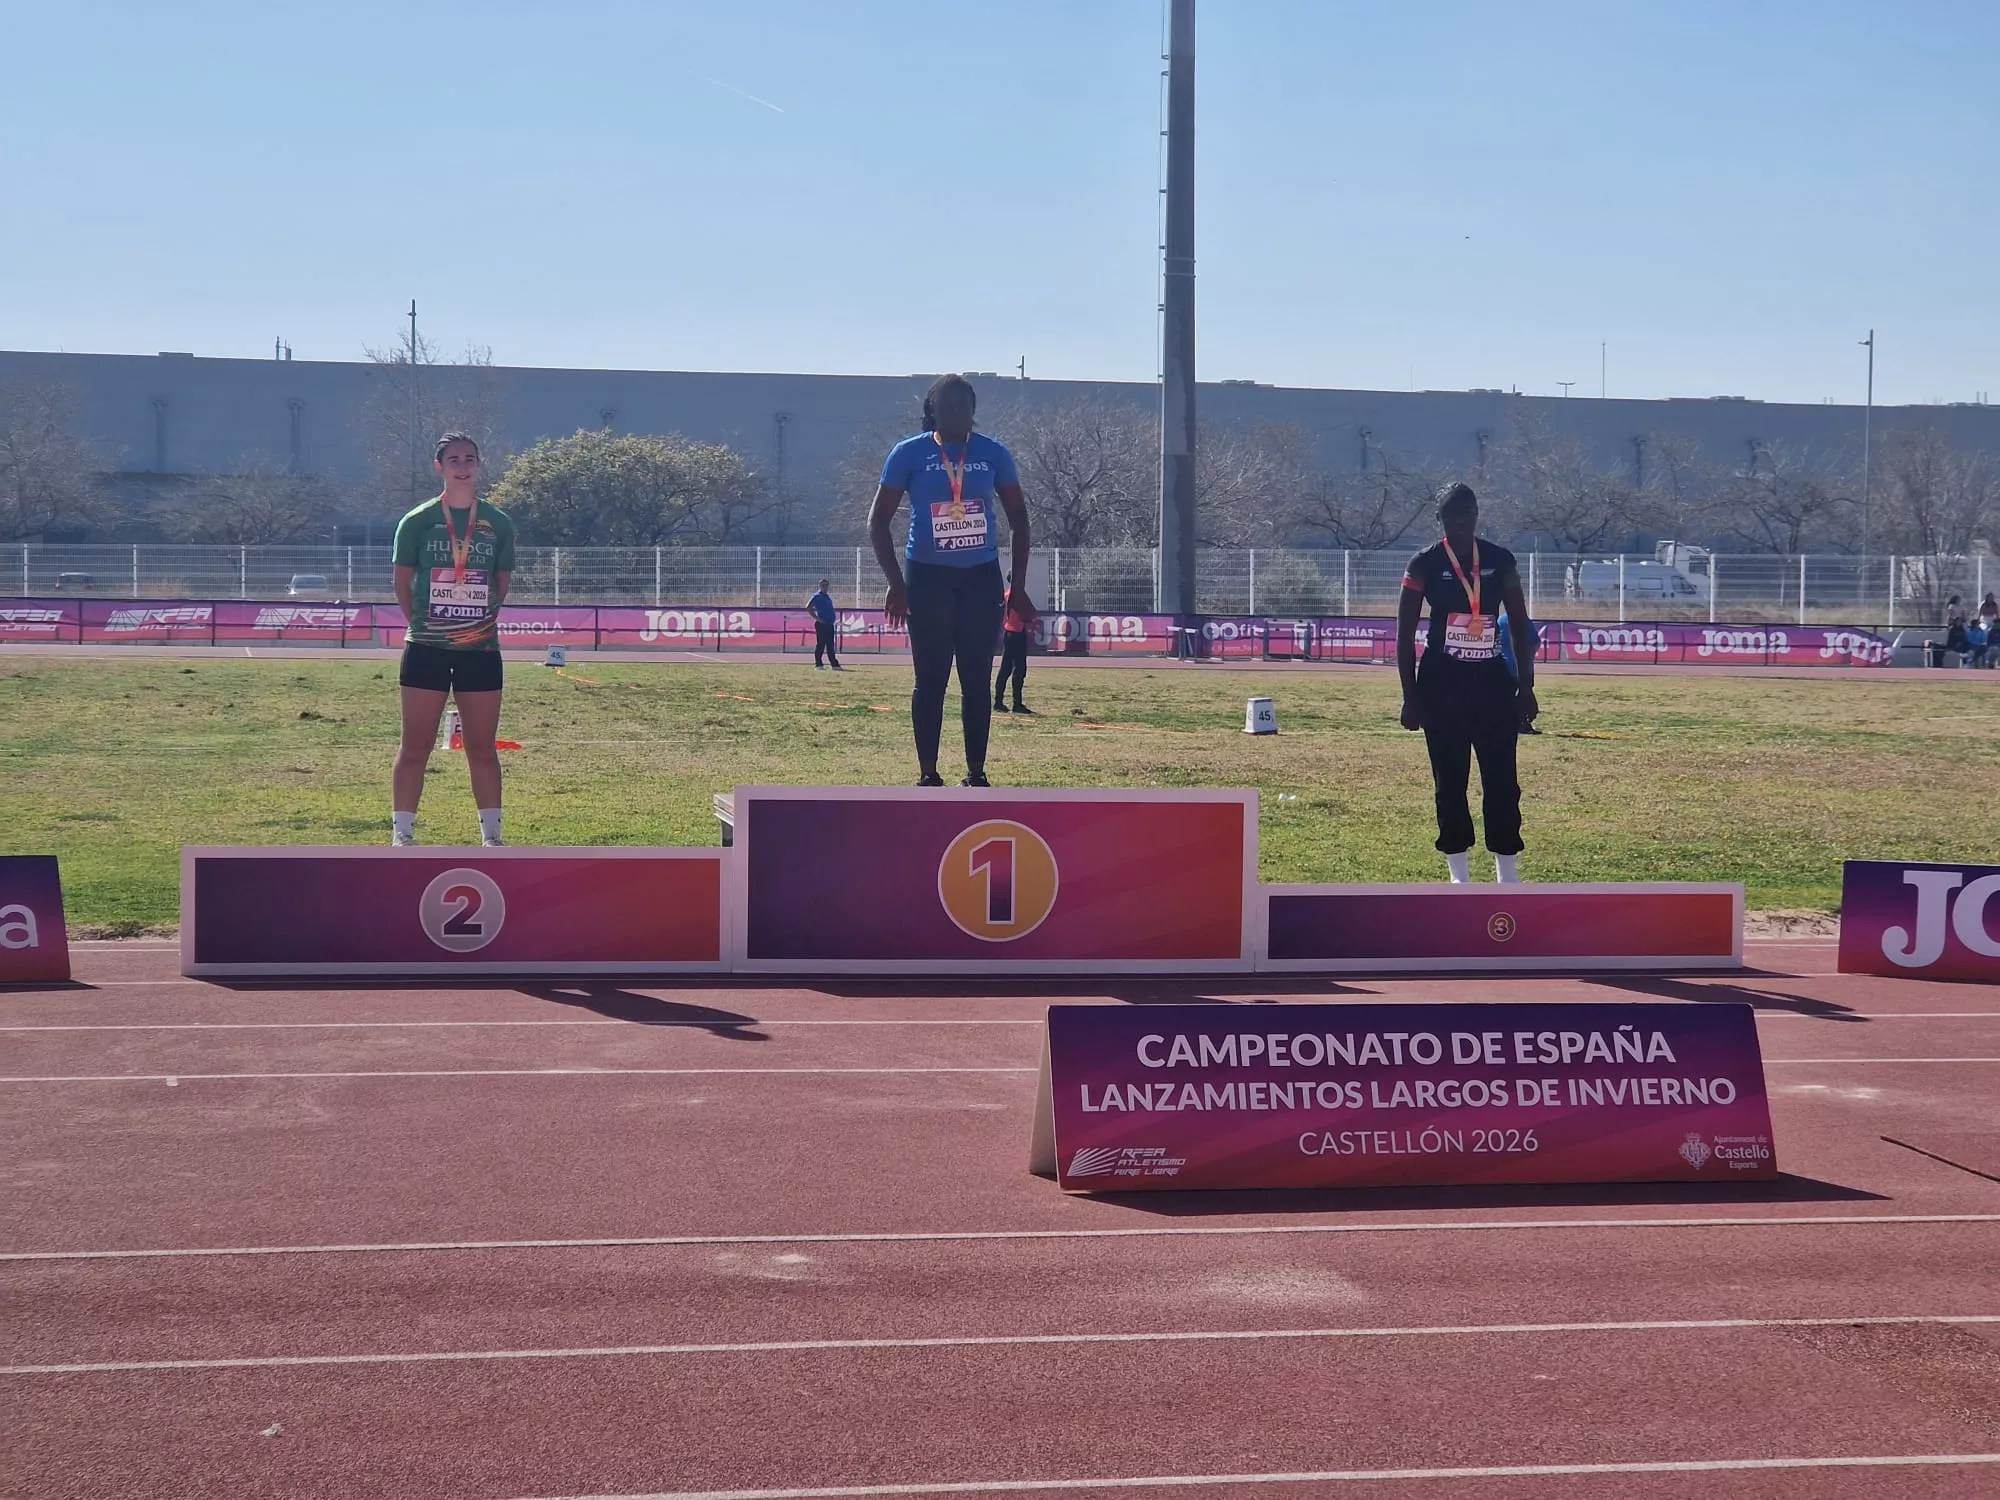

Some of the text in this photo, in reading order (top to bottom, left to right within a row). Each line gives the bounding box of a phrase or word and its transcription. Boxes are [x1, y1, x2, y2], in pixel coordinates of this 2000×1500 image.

[935, 521, 972, 532] CASTELLON
[969, 837, 1016, 925] 1
[442, 884, 484, 937] 2
[1495, 917, 1509, 936] 3
[1136, 1025, 1677, 1068] CAMPEONATO DE ESPAÑA
[1080, 1077, 1737, 1112] LANZAMIENTOS LARGOS DE INVIERNO
[1299, 1125, 1539, 1156] CASTELLÓN 2026
[1120, 1147, 1167, 1158] RFEA
[1714, 1145, 1770, 1159] Castelló
[1117, 1158, 1186, 1166] ATLETISMO
[1113, 1168, 1141, 1176] AIRE
